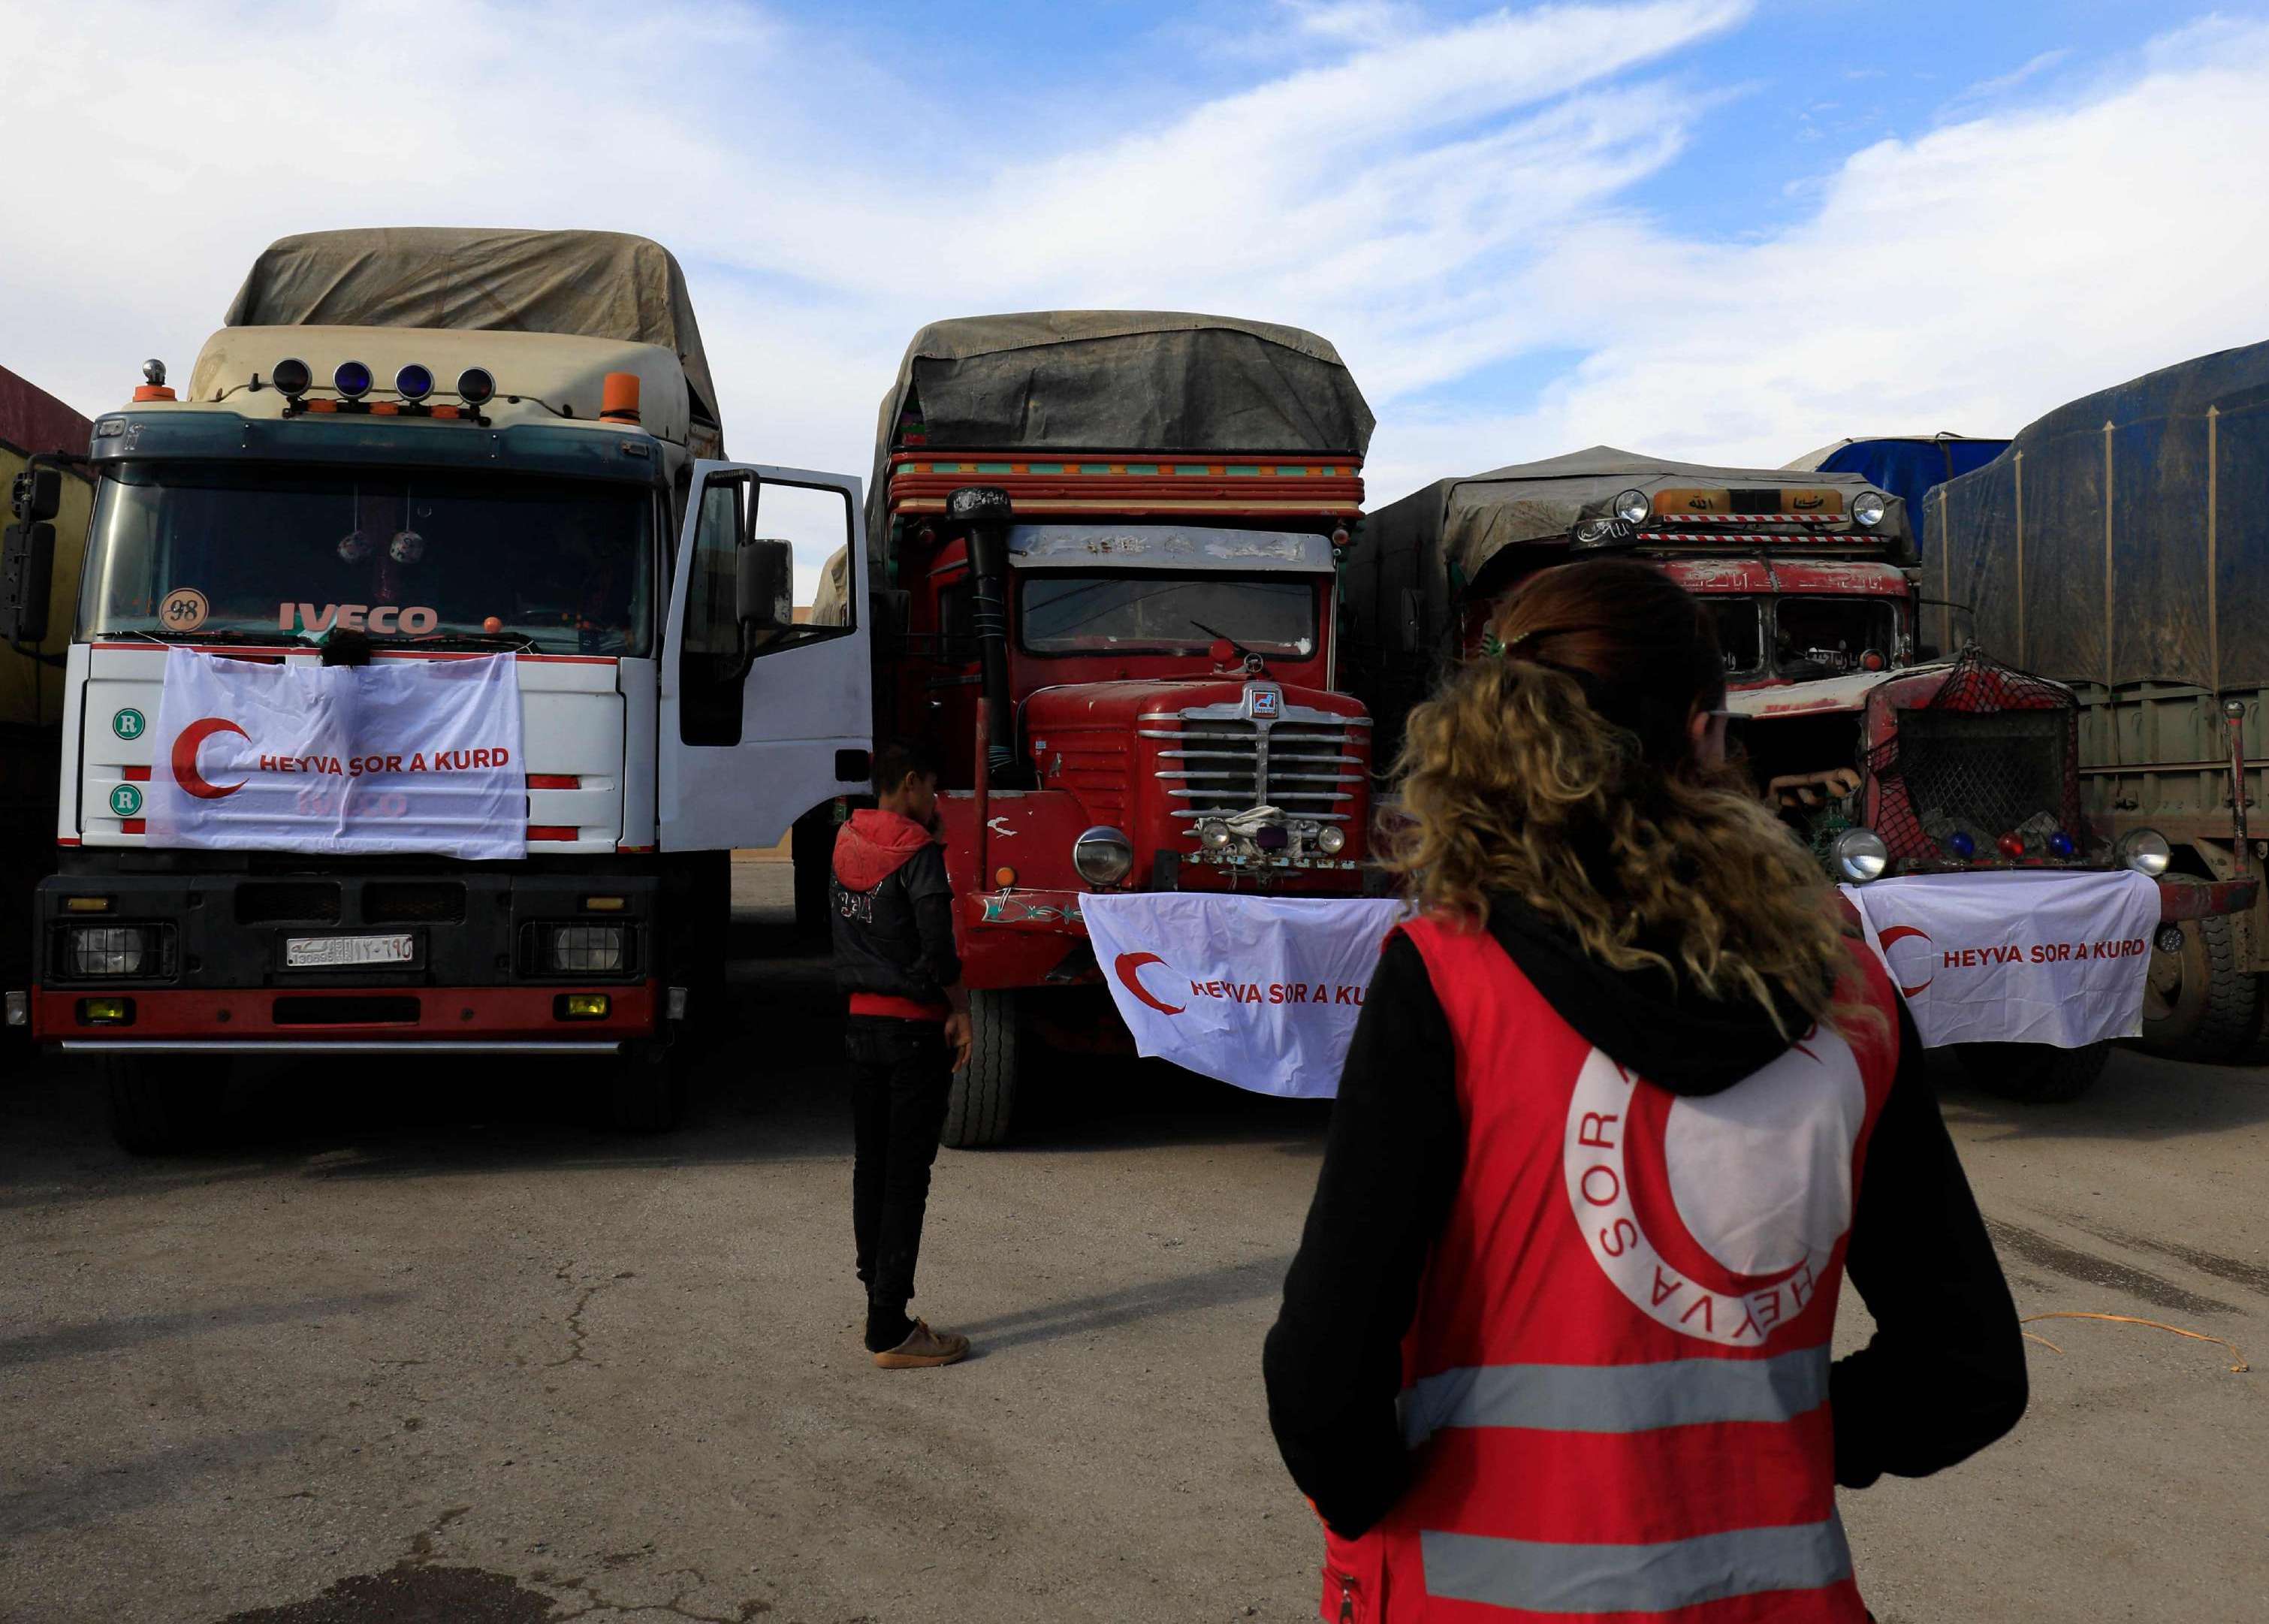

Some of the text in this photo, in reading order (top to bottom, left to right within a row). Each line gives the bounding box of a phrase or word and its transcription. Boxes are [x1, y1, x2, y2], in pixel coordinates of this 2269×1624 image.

[170, 600, 198, 621] 98
[279, 602, 438, 635] IVECO
[119, 715, 137, 732] R
[259, 747, 510, 777] HEYVA SOR A KURD
[117, 792, 134, 809] R
[1943, 937, 2146, 967] HEYVA SOR A KURD
[1190, 980, 1370, 1007] HEYVA SOR A KU
[1578, 1111, 1815, 1339] HEYVA SOR
